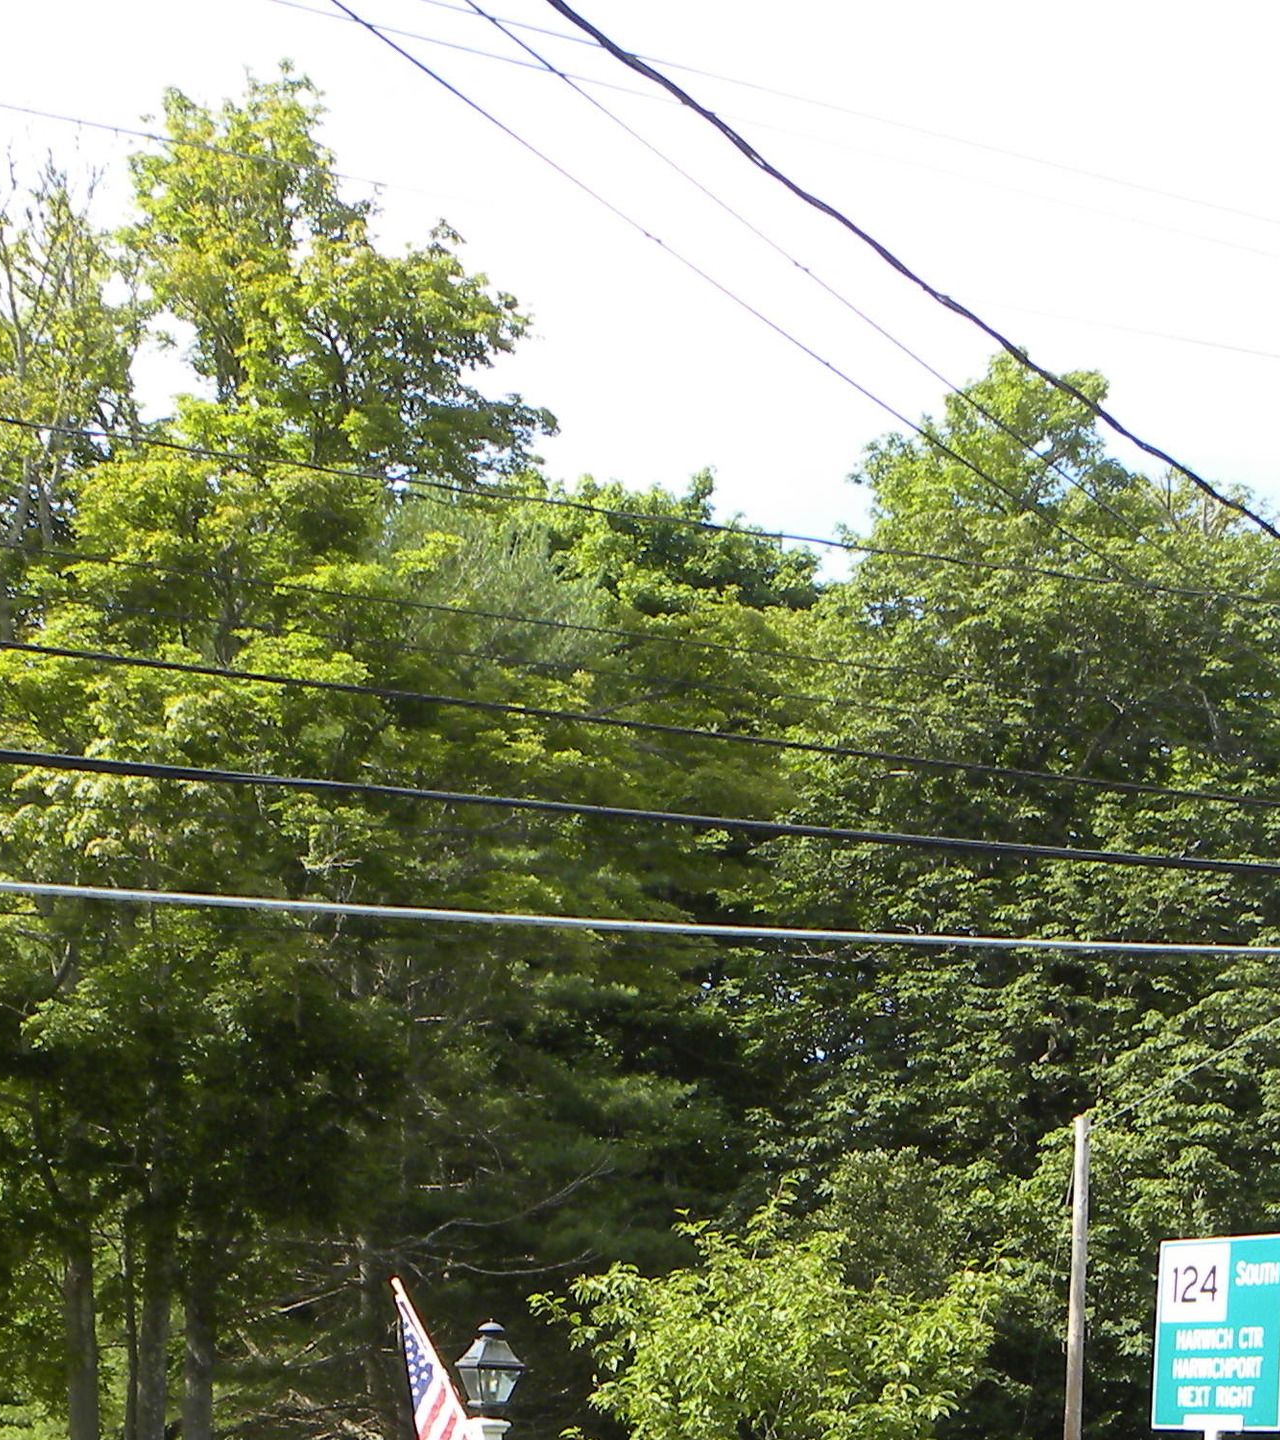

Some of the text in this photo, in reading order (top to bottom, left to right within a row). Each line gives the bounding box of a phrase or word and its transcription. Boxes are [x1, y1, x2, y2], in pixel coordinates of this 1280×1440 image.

[1173, 1265, 1218, 1303] 124
[1235, 1260, 1280, 1286] SOUTH
[1176, 1326, 1265, 1350] HARWICH CTR
[1173, 1356, 1263, 1379] HARWICHPORT
[1177, 1385, 1255, 1407] NEXT RIGHT
